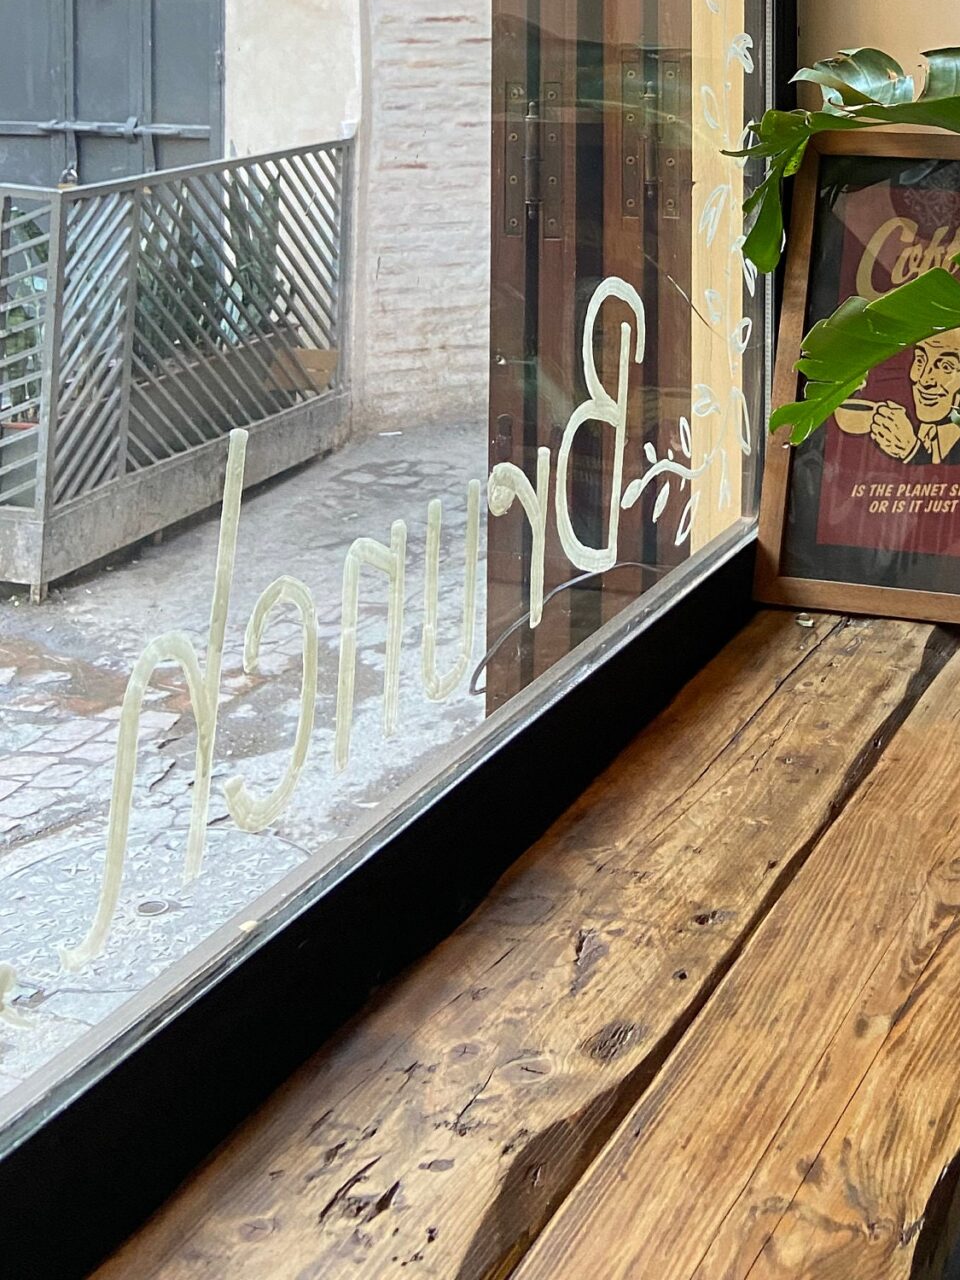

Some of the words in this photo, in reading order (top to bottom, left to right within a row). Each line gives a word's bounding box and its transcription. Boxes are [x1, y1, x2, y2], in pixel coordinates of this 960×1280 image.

[851, 483, 866, 498] IS
[868, 483, 894, 497] THE
[896, 483, 948, 497] PLANET
[868, 499, 888, 513] OR
[891, 499, 905, 513] IS
[908, 499, 924, 513] IT
[924, 499, 959, 513] JUST
